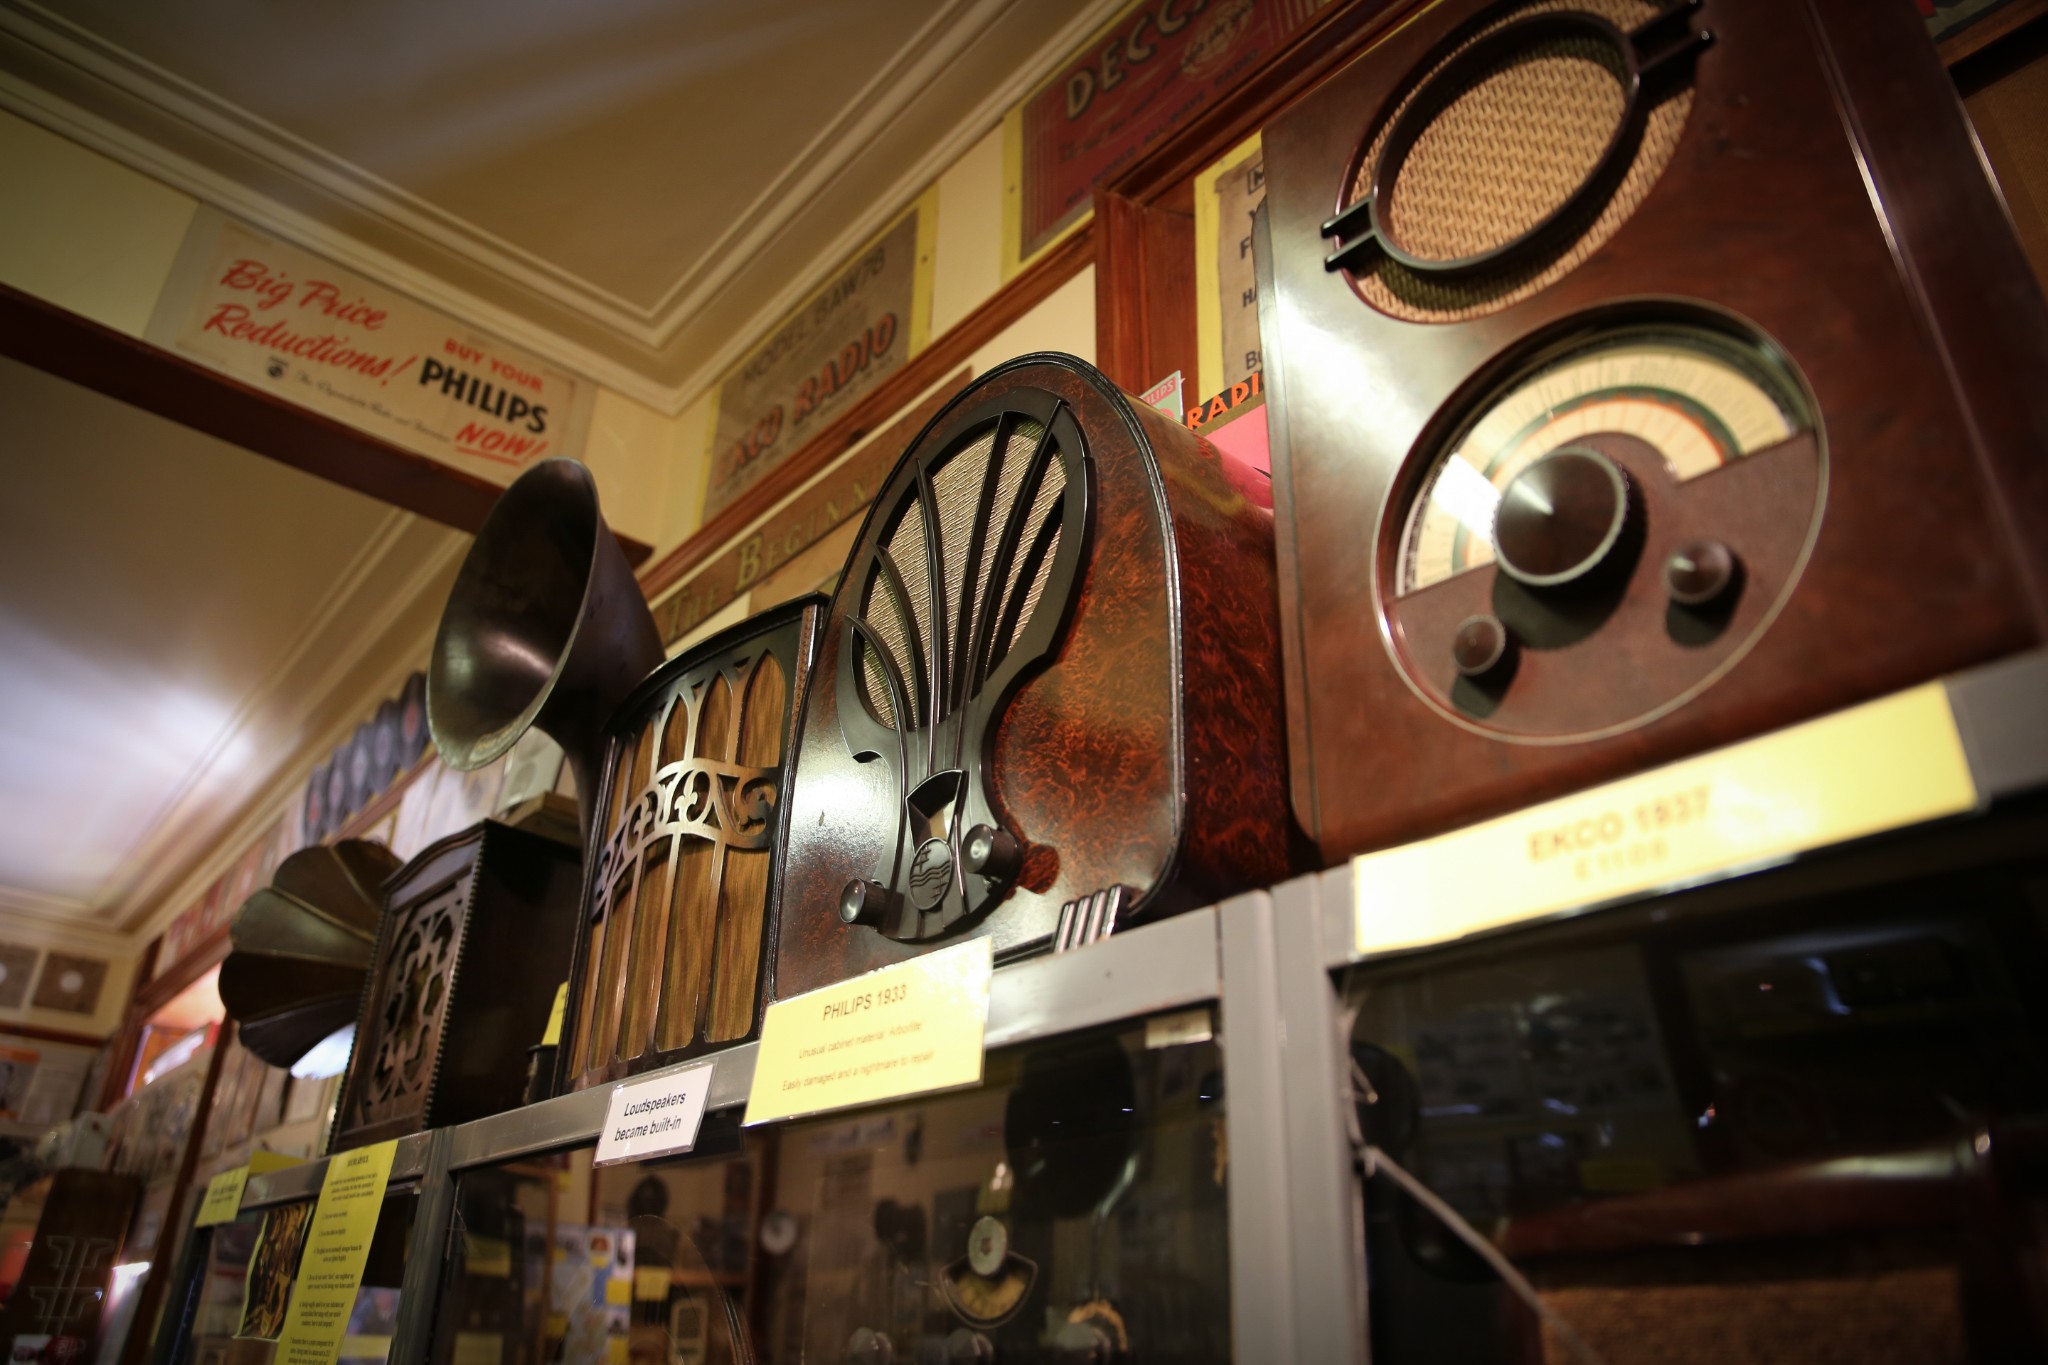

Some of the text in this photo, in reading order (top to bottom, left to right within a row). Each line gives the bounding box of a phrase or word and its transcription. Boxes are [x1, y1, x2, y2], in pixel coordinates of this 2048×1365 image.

[1066, 0, 1209, 121] DECC
[220, 259, 388, 331] Big Price
[203, 303, 418, 386] Reductions!
[444, 338, 544, 393] BUY YOUR
[793, 312, 898, 425] RADIO
[419, 356, 548, 435] PHILIPS
[1187, 371, 1265, 431] RADI
[456, 421, 550, 461] NOW!
[1529, 811, 1625, 862] EKCO
[823, 984, 907, 1021] PHILIPS 1933
[782, 1079, 801, 1092] Easily
[803, 1071, 836, 1087] damaged
[837, 1067, 852, 1079] and
[860, 1058, 898, 1077] nightmare
[911, 1050, 936, 1065] repair
[799, 1042, 827, 1060] Unusual
[828, 1037, 854, 1053] cabinet
[614, 1115, 682, 1141] became built-in
[624, 1093, 686, 1117] Loudspeakers
